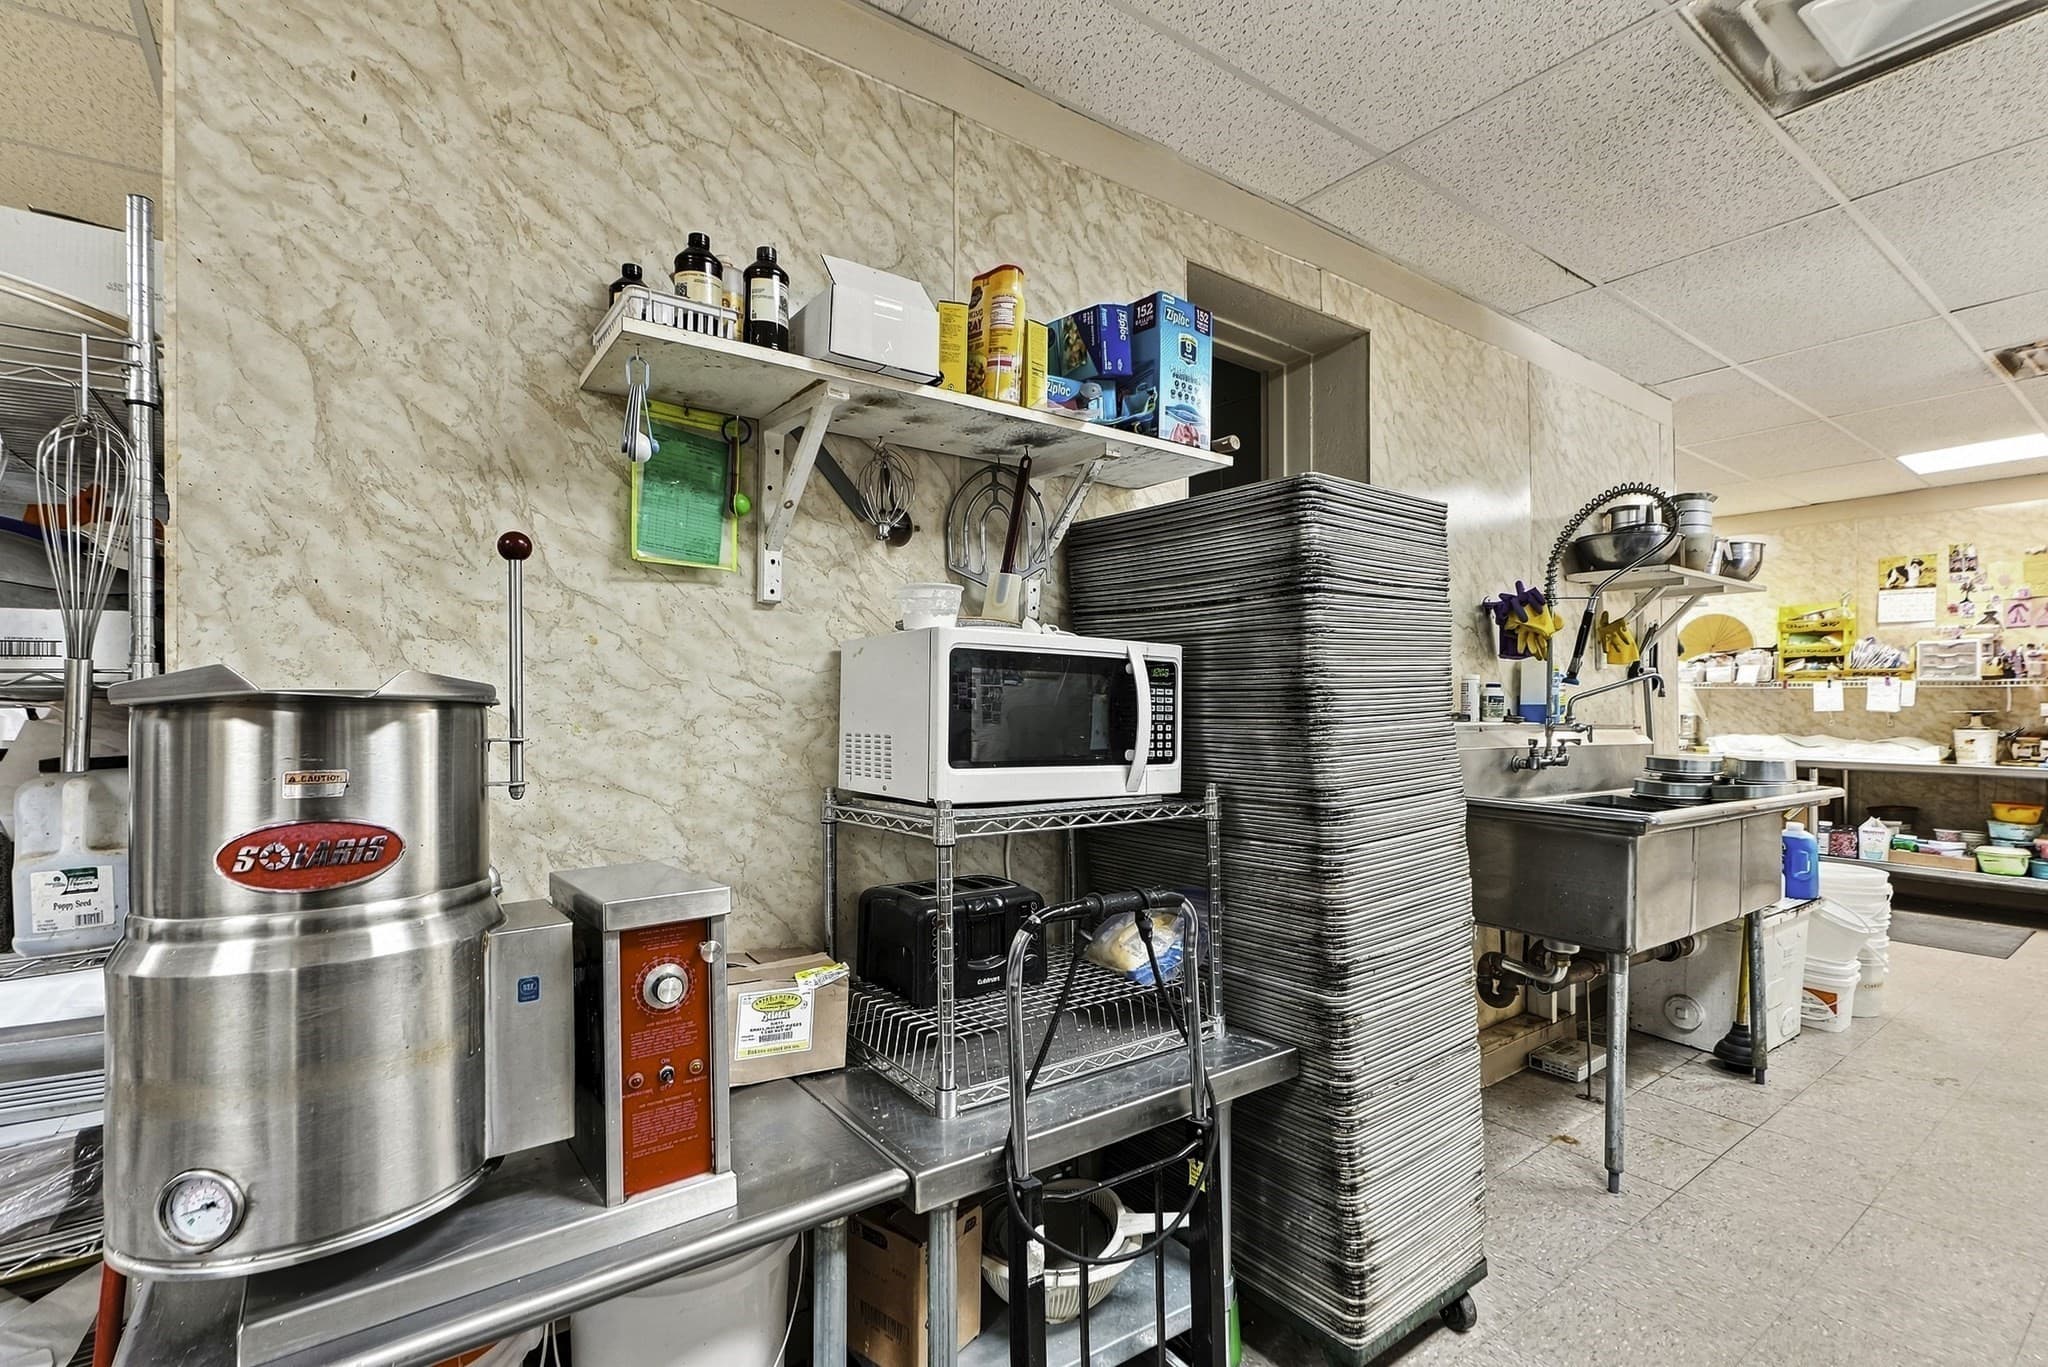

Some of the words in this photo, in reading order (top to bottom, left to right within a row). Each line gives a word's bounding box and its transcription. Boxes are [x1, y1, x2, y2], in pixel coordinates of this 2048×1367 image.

[1137, 302, 1154, 319] 152
[1166, 307, 1190, 327] Ziploc
[1196, 309, 1209, 324] 152
[1185, 340, 1193, 353] 9
[1047, 381, 1071, 397] Ziploc
[300, 774, 343, 783] CAUTIO
[231, 834, 388, 873] SOLARIS
[53, 902, 74, 911] Poppy
[75, 899, 92, 909] Seed
